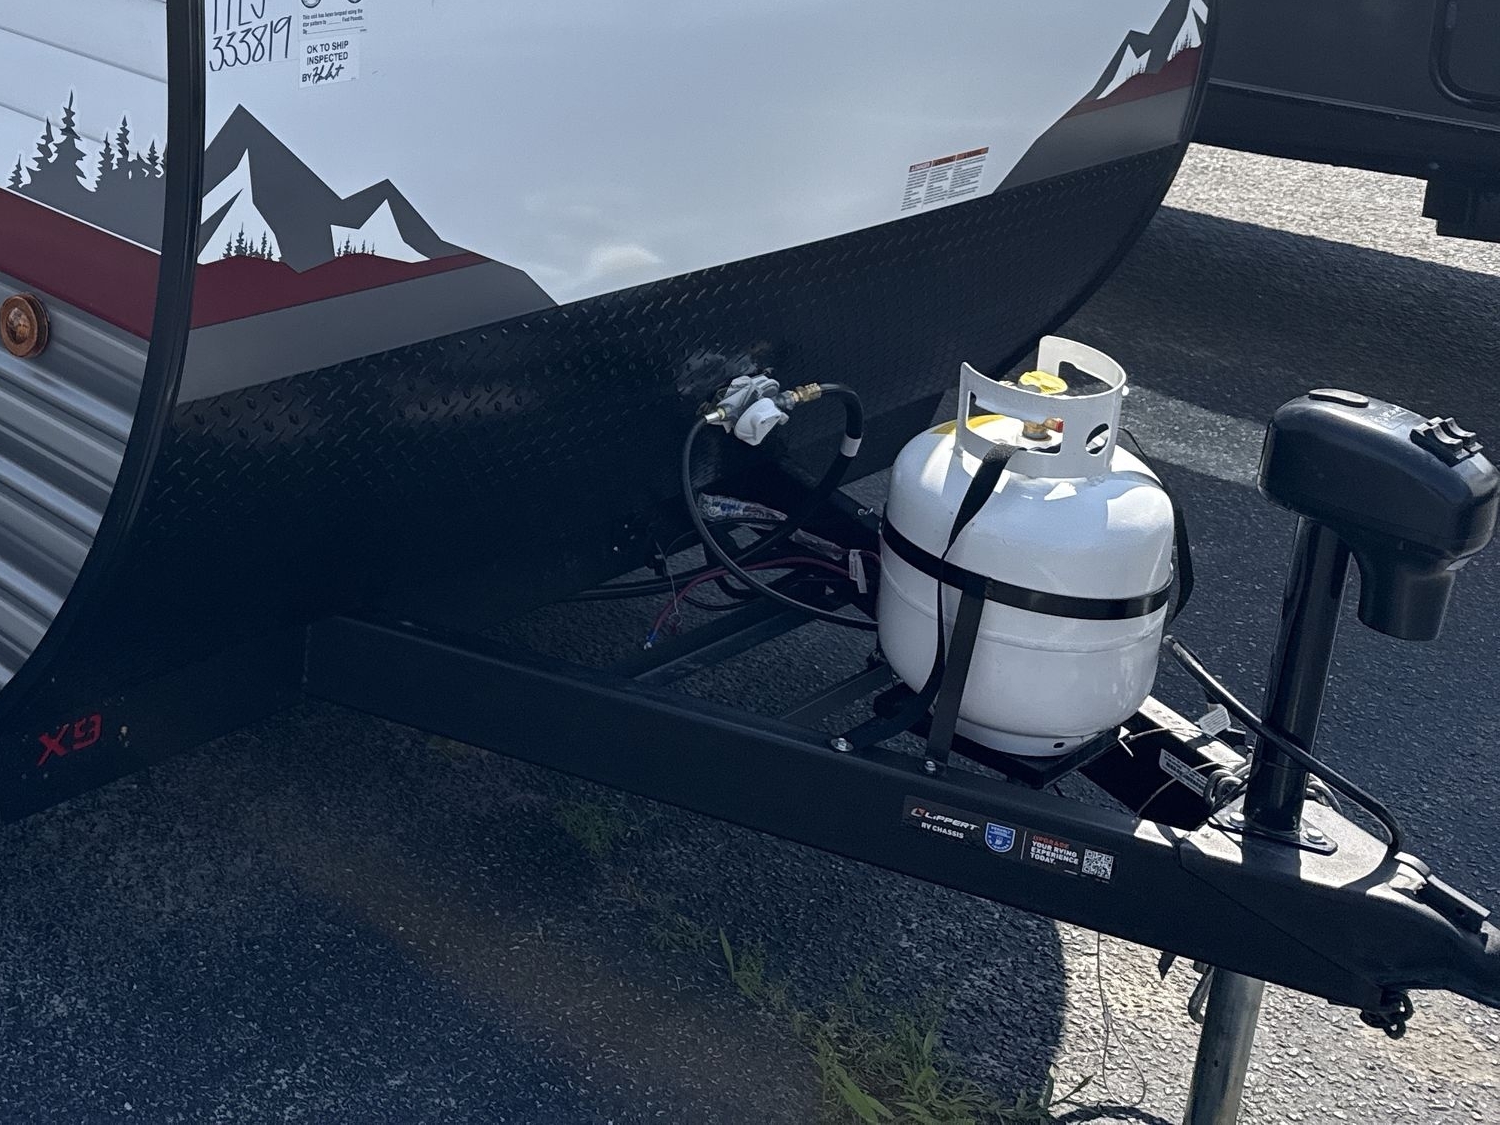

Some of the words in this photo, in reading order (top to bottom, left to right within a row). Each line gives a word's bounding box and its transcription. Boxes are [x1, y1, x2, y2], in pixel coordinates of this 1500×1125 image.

[209, 15, 292, 71] 333819
[306, 45, 318, 54] OK
[320, 43, 330, 52] TO
[331, 40, 348, 50] SHIP
[306, 51, 348, 66] INSPECTED
[302, 73, 312, 82] BY
[921, 821, 931, 830] RV
[932, 825, 964, 839] CHASSIS
[1031, 846, 1079, 865] EXPERIENCE
[1032, 841, 1053, 852] YOUR
[1053, 846, 1078, 858] RVING
[1030, 852, 1056, 865] TODAY.
